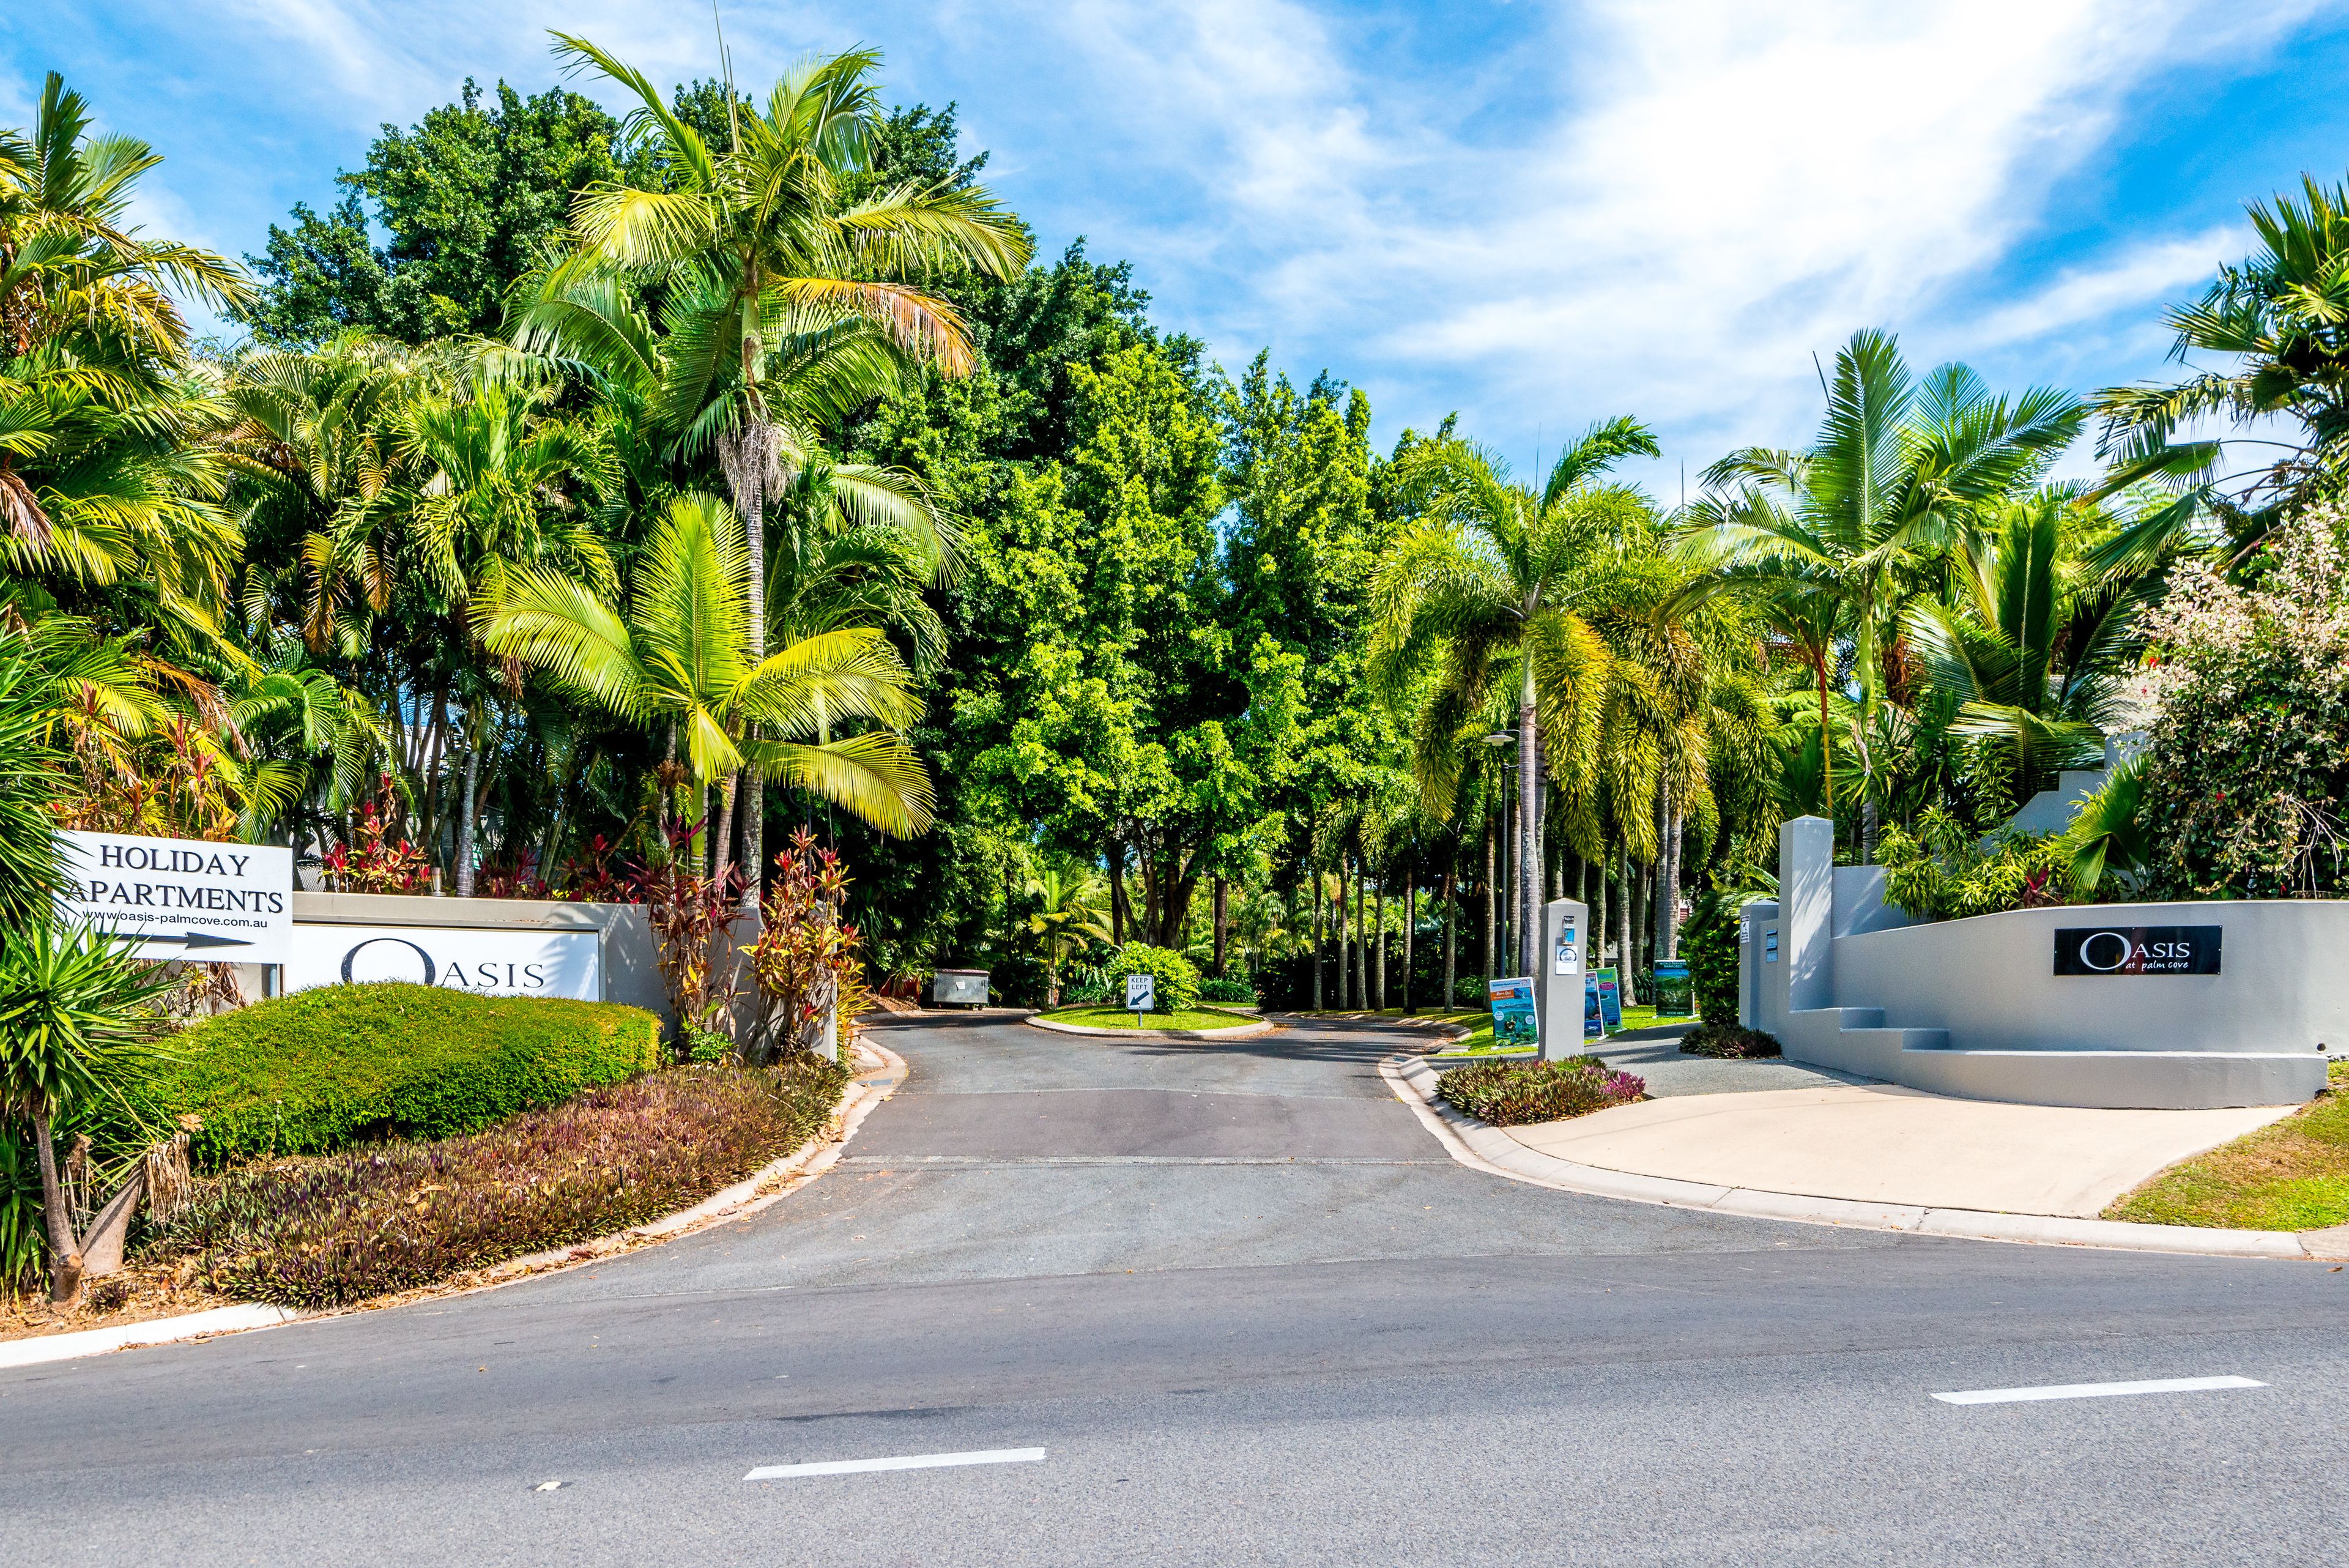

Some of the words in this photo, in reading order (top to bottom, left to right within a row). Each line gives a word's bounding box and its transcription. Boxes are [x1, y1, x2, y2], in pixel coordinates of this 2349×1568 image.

[100, 844, 250, 876] HOLIDAY
[64, 879, 283, 914] APARTMENTS
[83, 911, 267, 927] www.oasis-palmcove.com.au
[341, 938, 544, 988] OASIS
[2080, 932, 2190, 970] OASIS
[2141, 960, 2165, 971] palm
